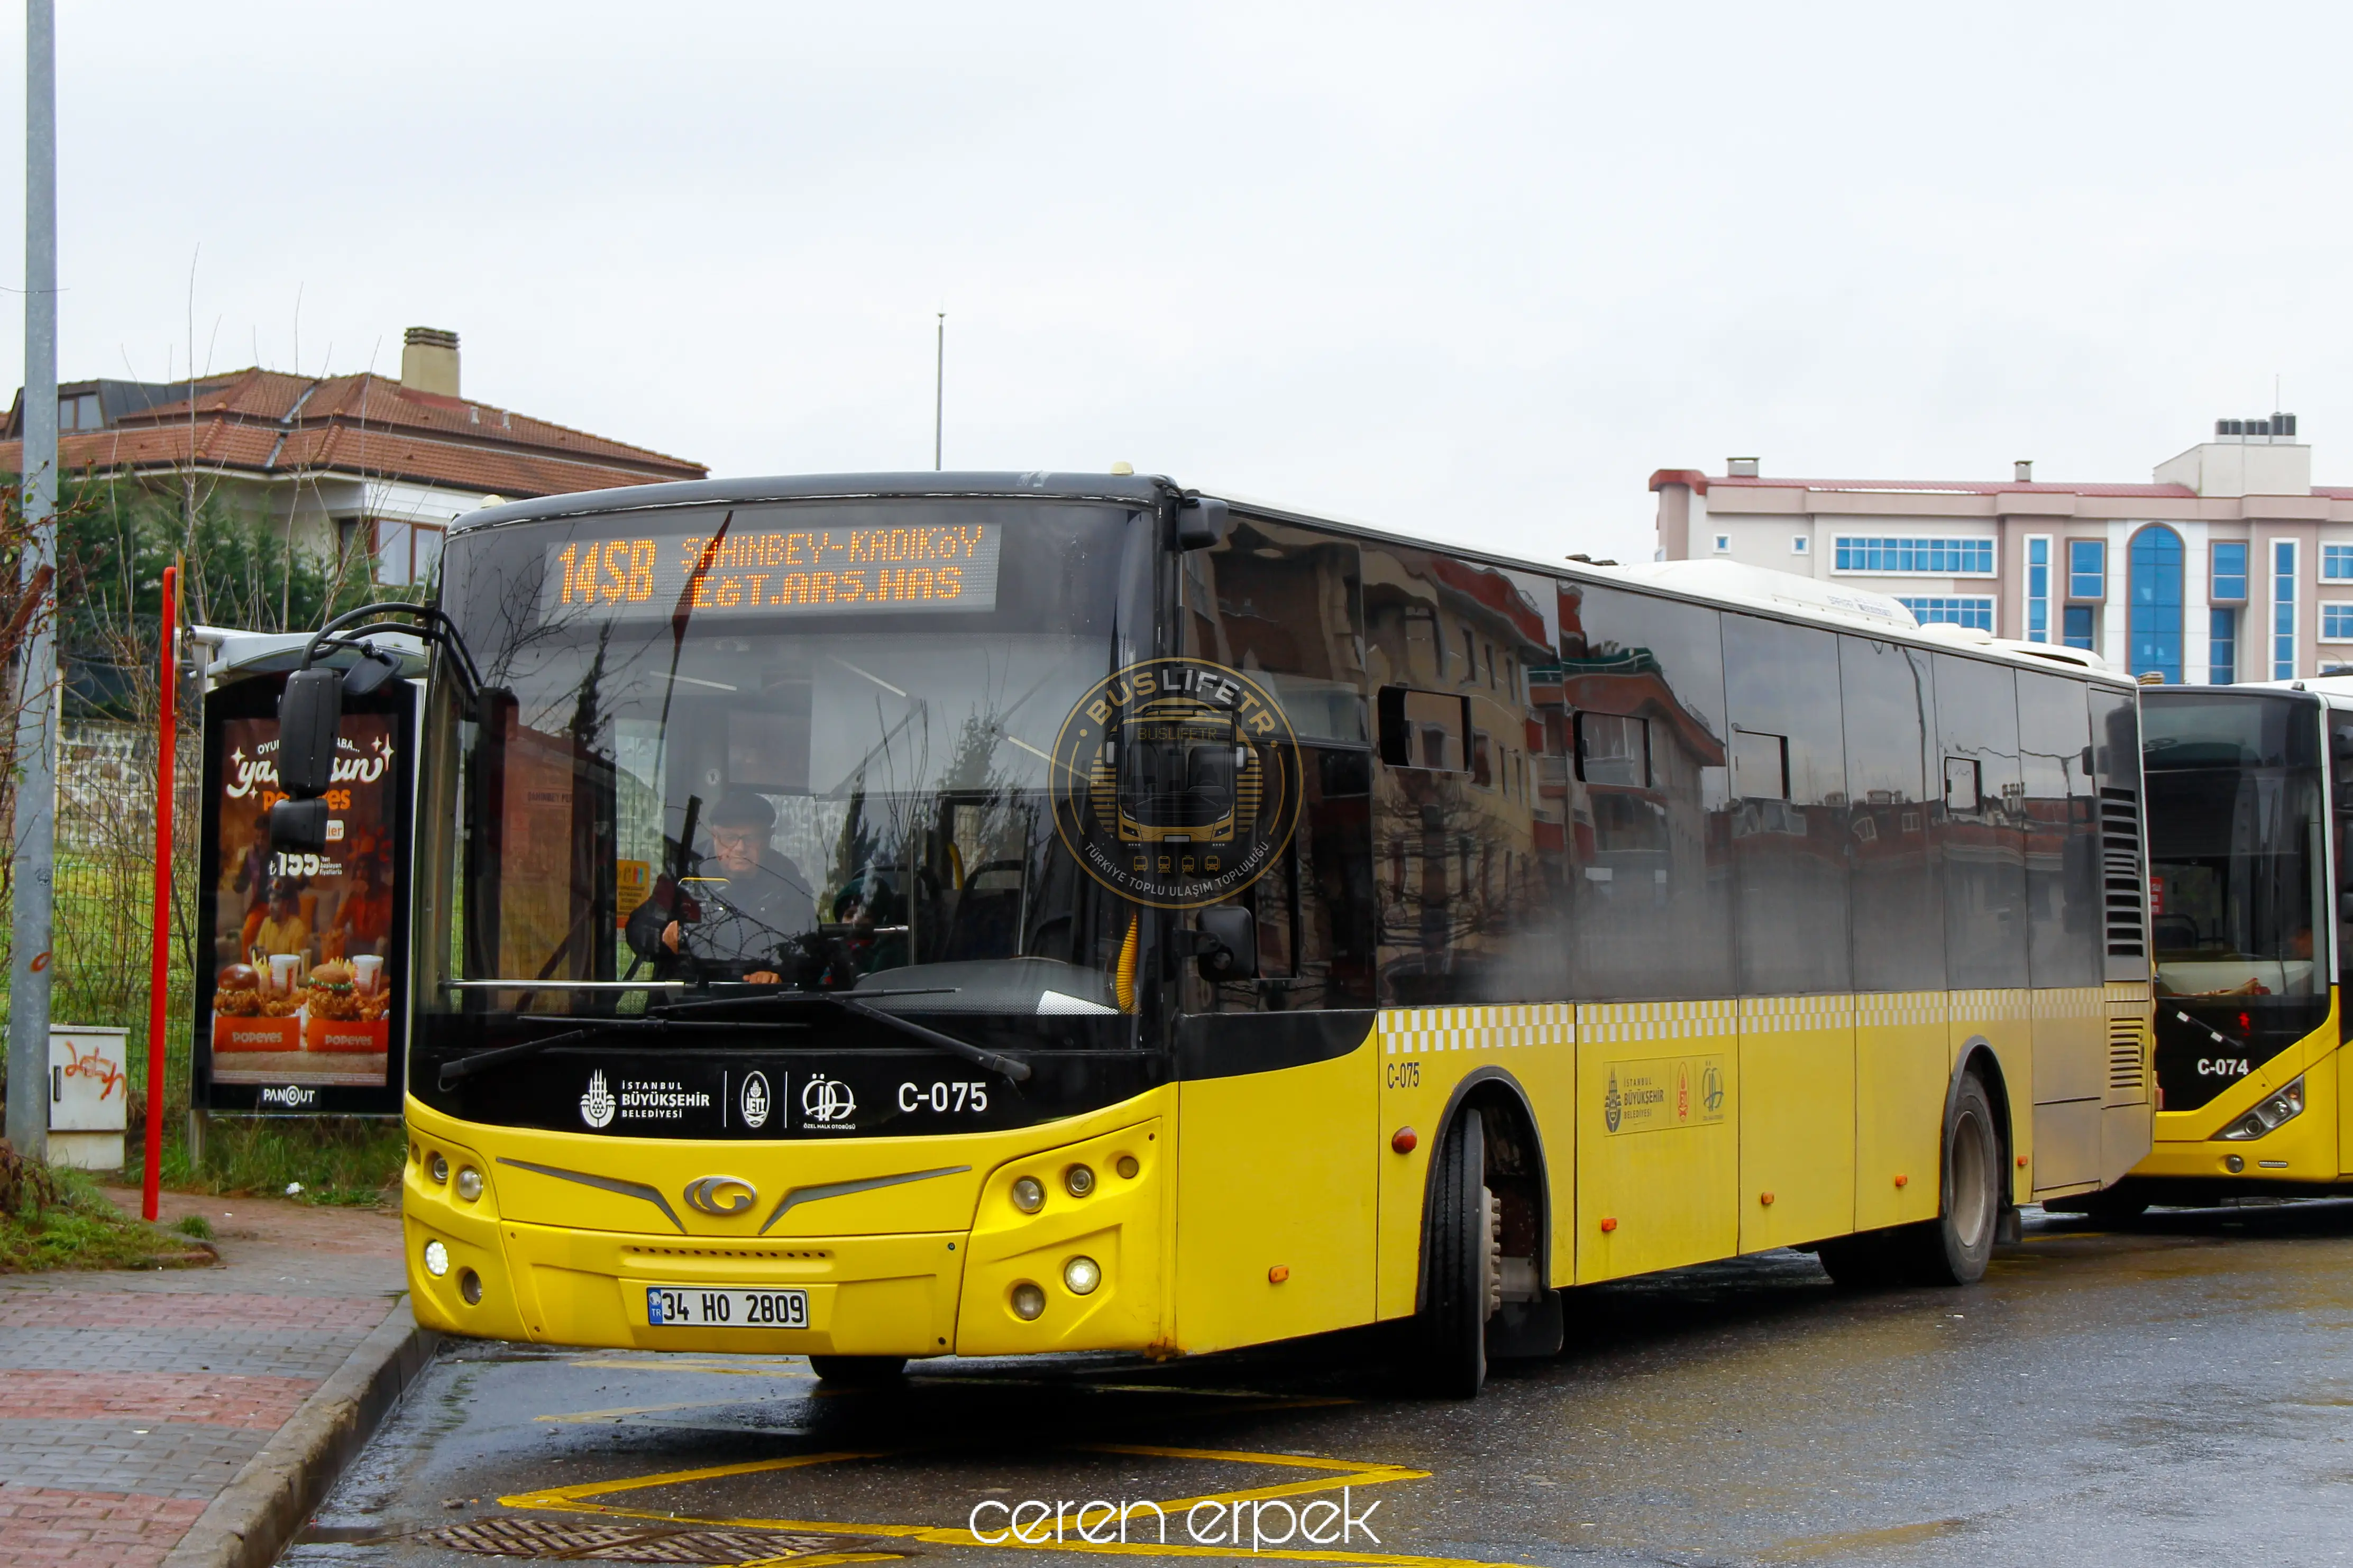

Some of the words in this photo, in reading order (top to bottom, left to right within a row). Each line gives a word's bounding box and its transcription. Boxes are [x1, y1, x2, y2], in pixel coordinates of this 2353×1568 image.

[1387, 1062, 1420, 1089] C-075
[2197, 1058, 2249, 1076] C-074
[621, 1080, 683, 1090] İSTANBUL
[1624, 1077, 1652, 1087] İSTANBUL
[264, 1085, 315, 1106] PANOUT
[621, 1091, 710, 1107] BÜYÜKŞEHİR
[899, 1081, 988, 1112] C-075
[1624, 1087, 1664, 1106] BÜYÜKŞEHİR
[621, 1108, 682, 1118] BELEDİYESİ
[651, 1308, 661, 1317] TR
[662, 1292, 690, 1321] 34
[746, 1294, 804, 1323] 2809
